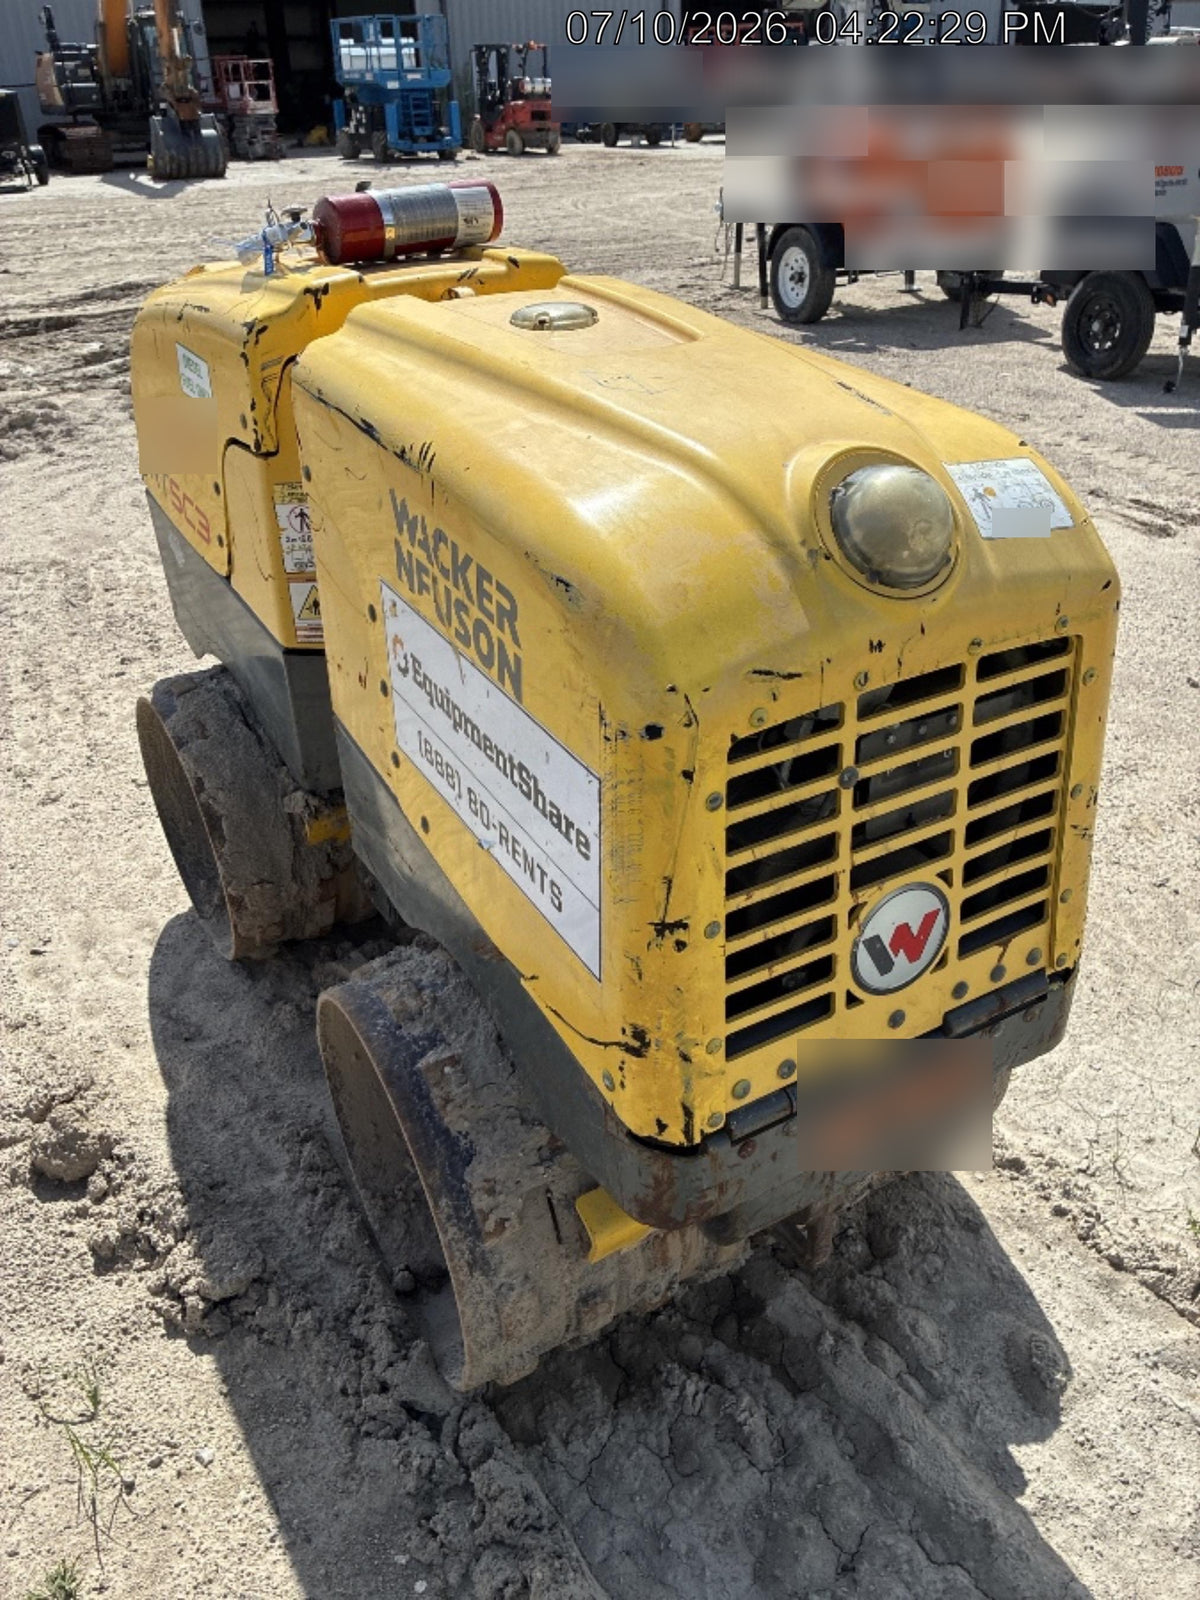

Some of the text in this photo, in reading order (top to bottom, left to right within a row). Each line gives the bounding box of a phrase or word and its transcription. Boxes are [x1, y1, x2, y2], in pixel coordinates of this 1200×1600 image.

[389, 488, 521, 649] WACKER
[410, 652, 592, 861] EquipmentShare
[467, 786, 564, 913] 80-RENTS
